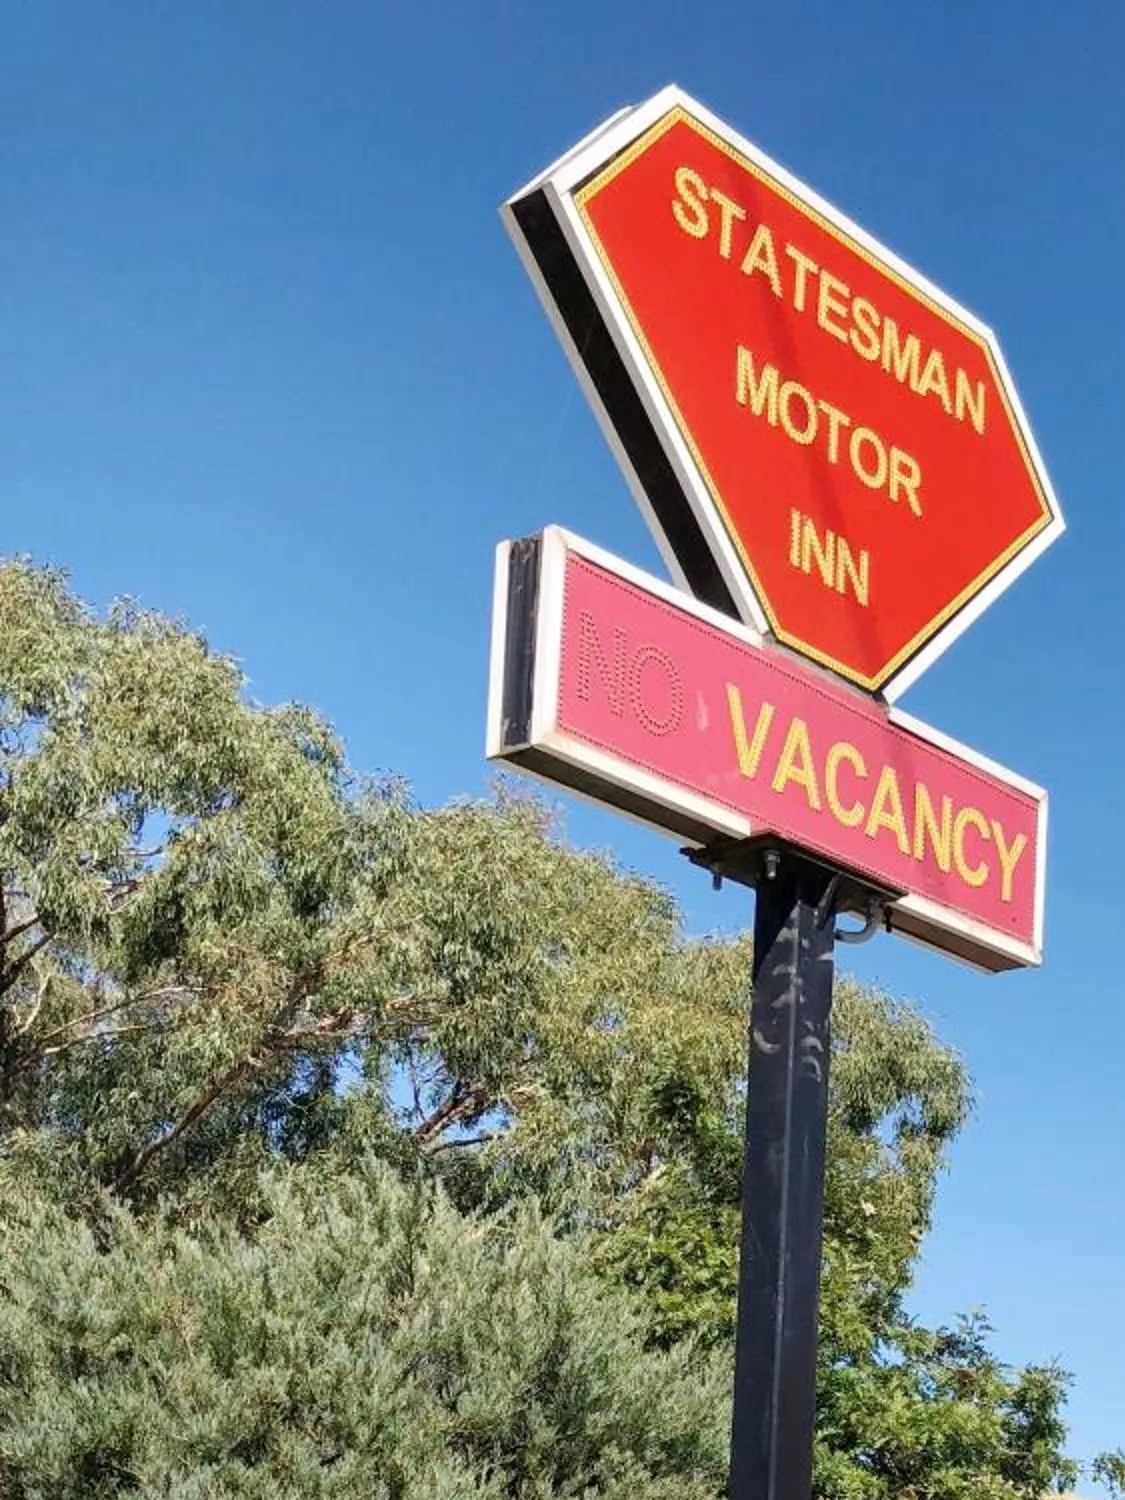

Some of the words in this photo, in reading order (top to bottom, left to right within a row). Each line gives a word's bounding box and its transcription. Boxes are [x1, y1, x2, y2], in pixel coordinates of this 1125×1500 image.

[672, 165, 986, 435] STATESMAN
[736, 345, 923, 516] MOTOR
[789, 508, 869, 607] INN
[577, 611, 683, 736] NO
[727, 683, 1028, 903] VACANCY
